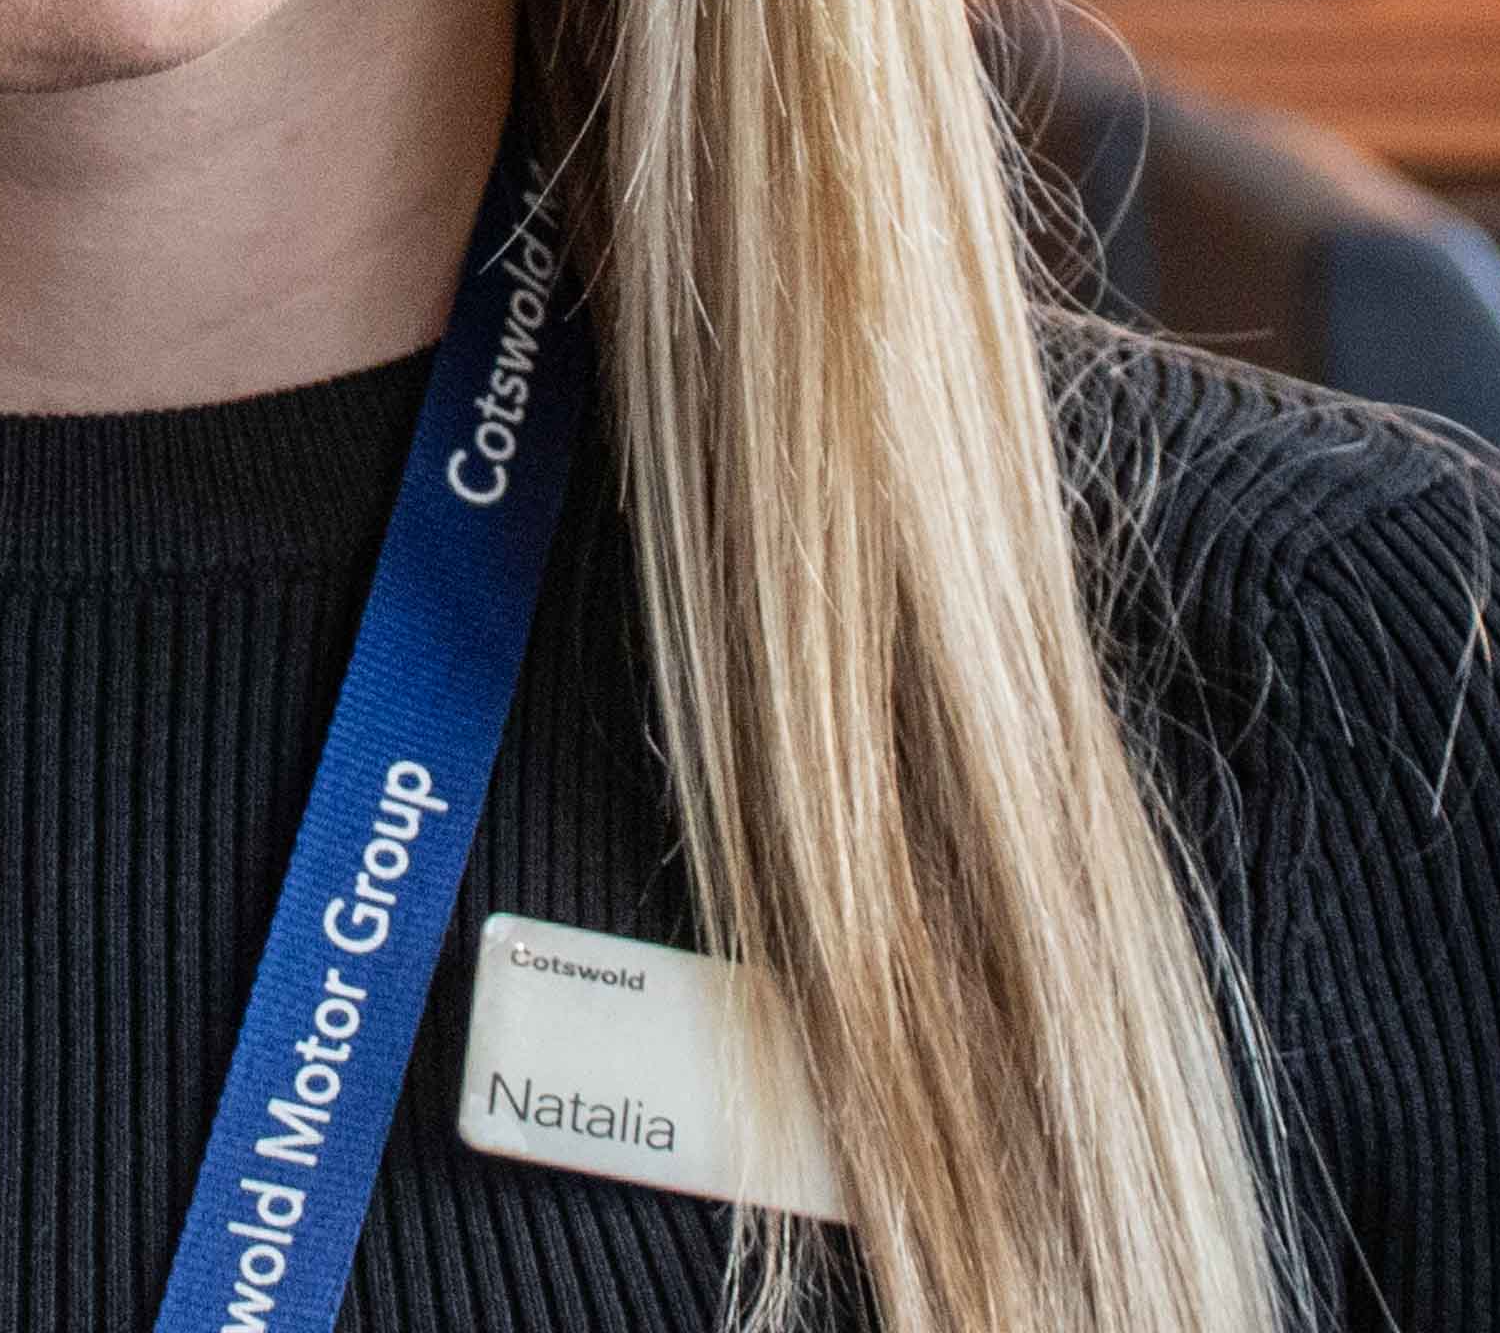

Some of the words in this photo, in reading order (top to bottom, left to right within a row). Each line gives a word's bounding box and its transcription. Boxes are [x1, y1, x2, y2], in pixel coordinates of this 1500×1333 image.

[447, 223, 554, 505] Cotswold
[254, 967, 368, 1167] Motor
[322, 760, 449, 954] Group
[509, 947, 647, 993] Cotswold
[487, 1071, 677, 1153] Natalia
